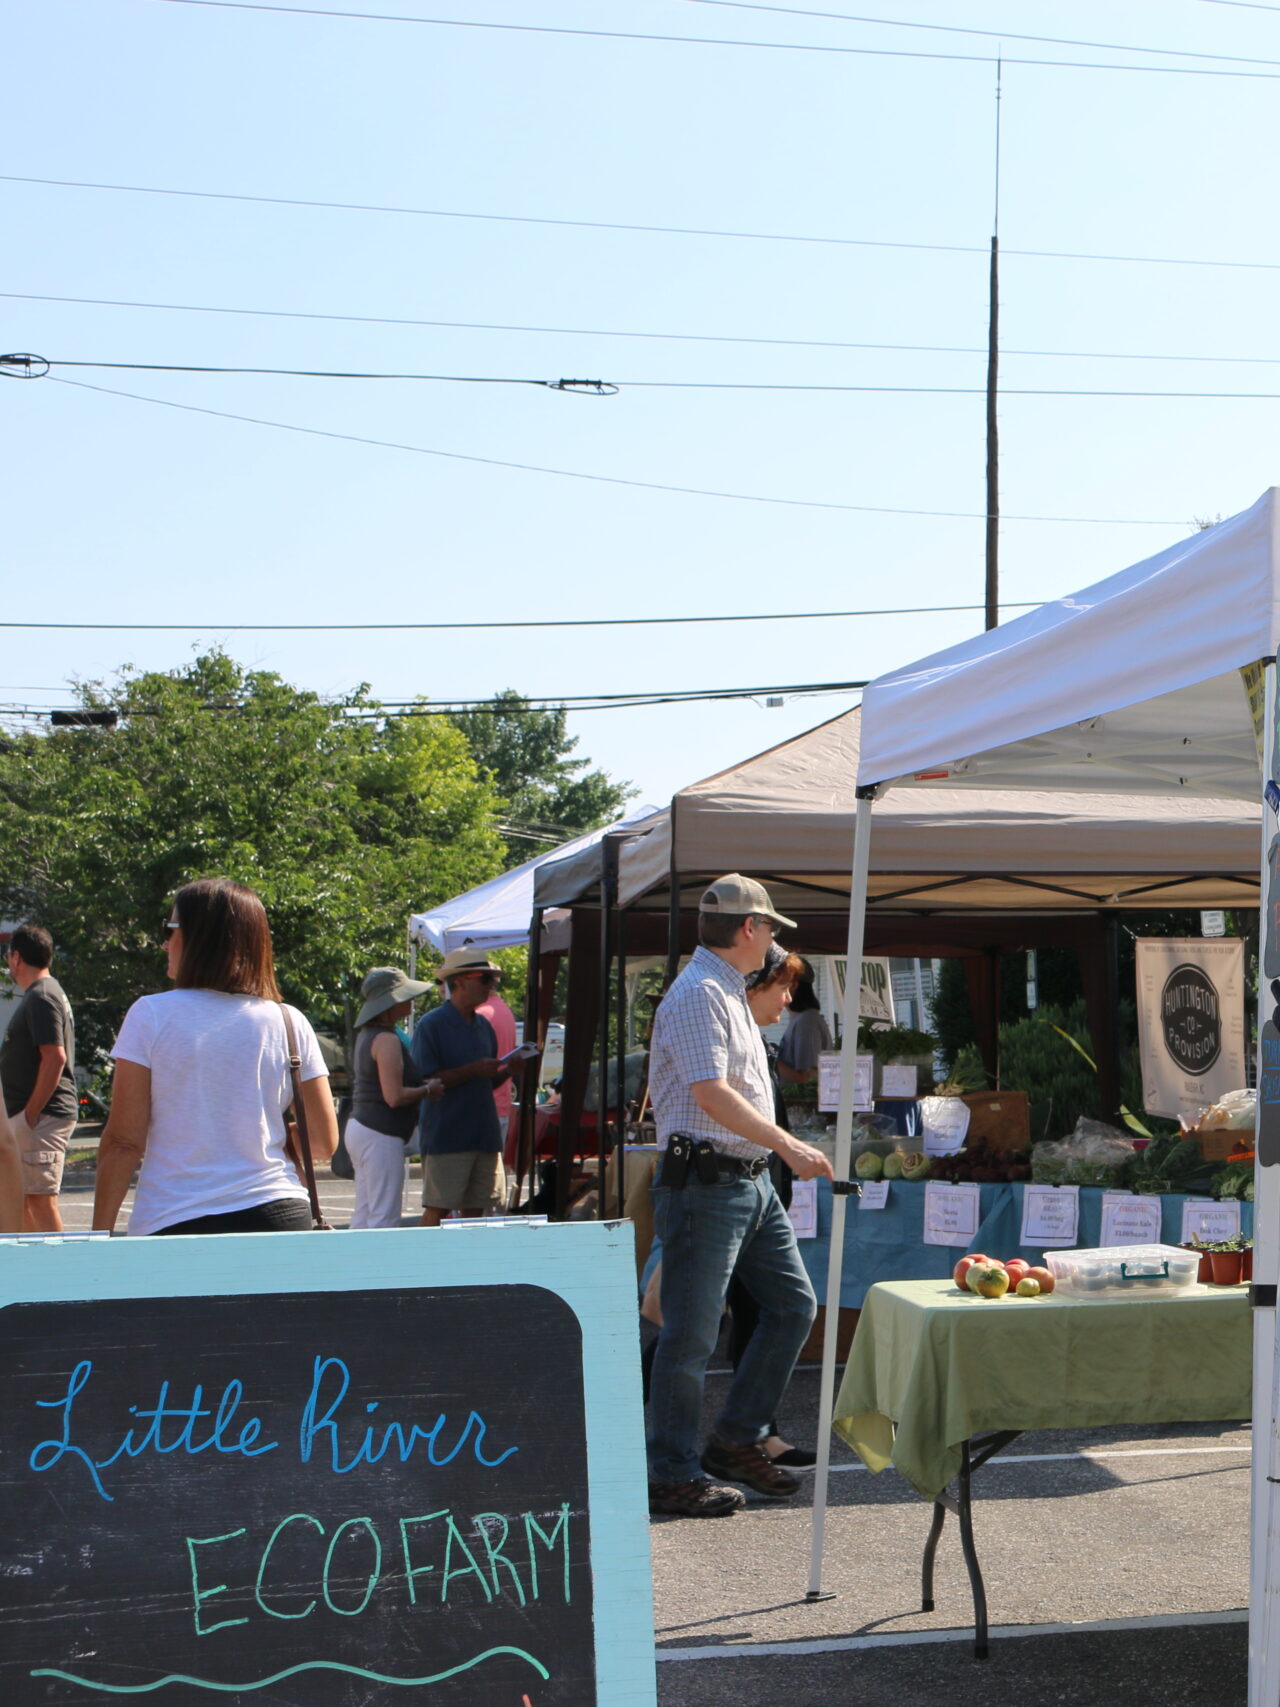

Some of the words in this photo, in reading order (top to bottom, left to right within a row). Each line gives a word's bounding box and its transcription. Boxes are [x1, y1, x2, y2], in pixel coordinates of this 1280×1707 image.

[1165, 984, 1217, 1021] HUNTINGTON
[1168, 1027, 1215, 1059] PROVISION
[29, 1360, 279, 1502] Little
[300, 1354, 519, 1474] River
